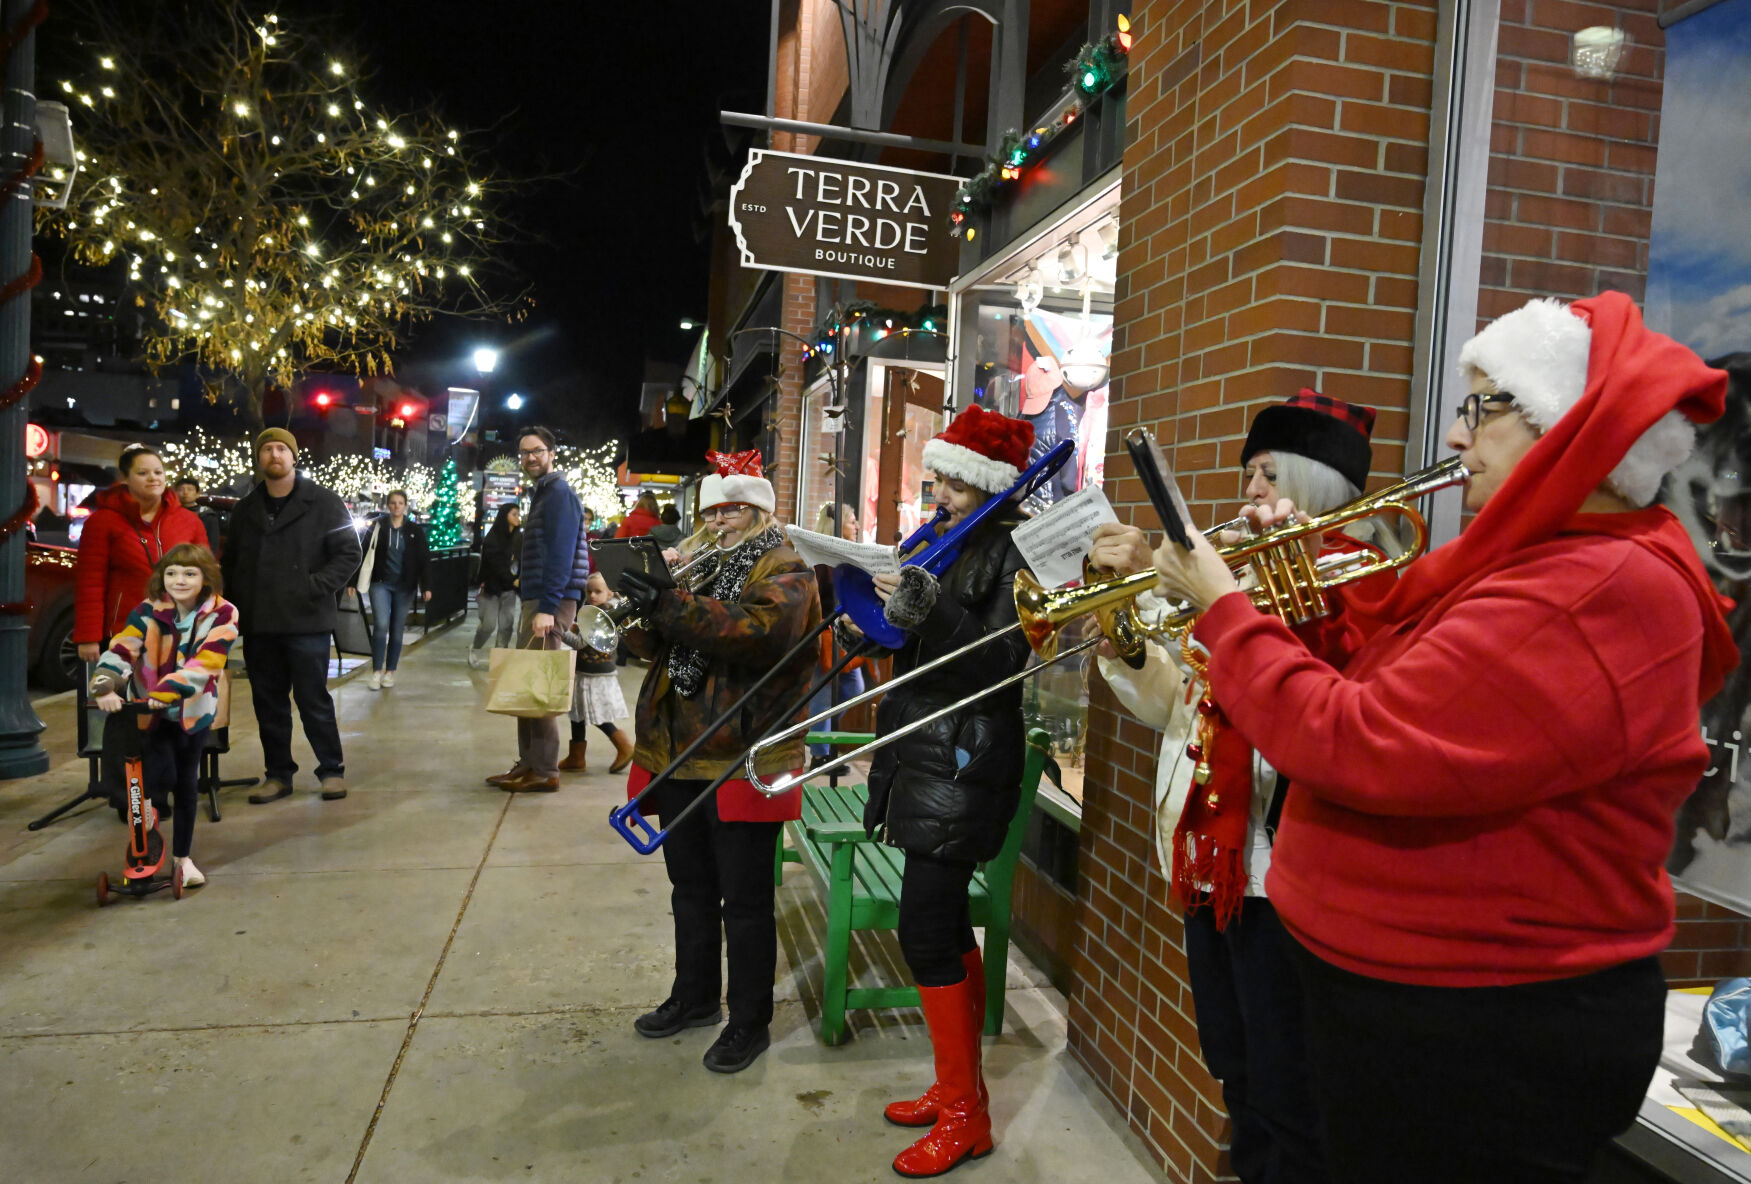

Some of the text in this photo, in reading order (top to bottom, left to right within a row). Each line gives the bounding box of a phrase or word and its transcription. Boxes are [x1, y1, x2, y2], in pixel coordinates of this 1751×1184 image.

[741, 203, 767, 213] ESTD
[787, 167, 931, 217] TERRA
[785, 206, 929, 255] VERDE
[815, 249, 896, 269] BOUTIQUE
[130, 785, 142, 826] Glider XL
